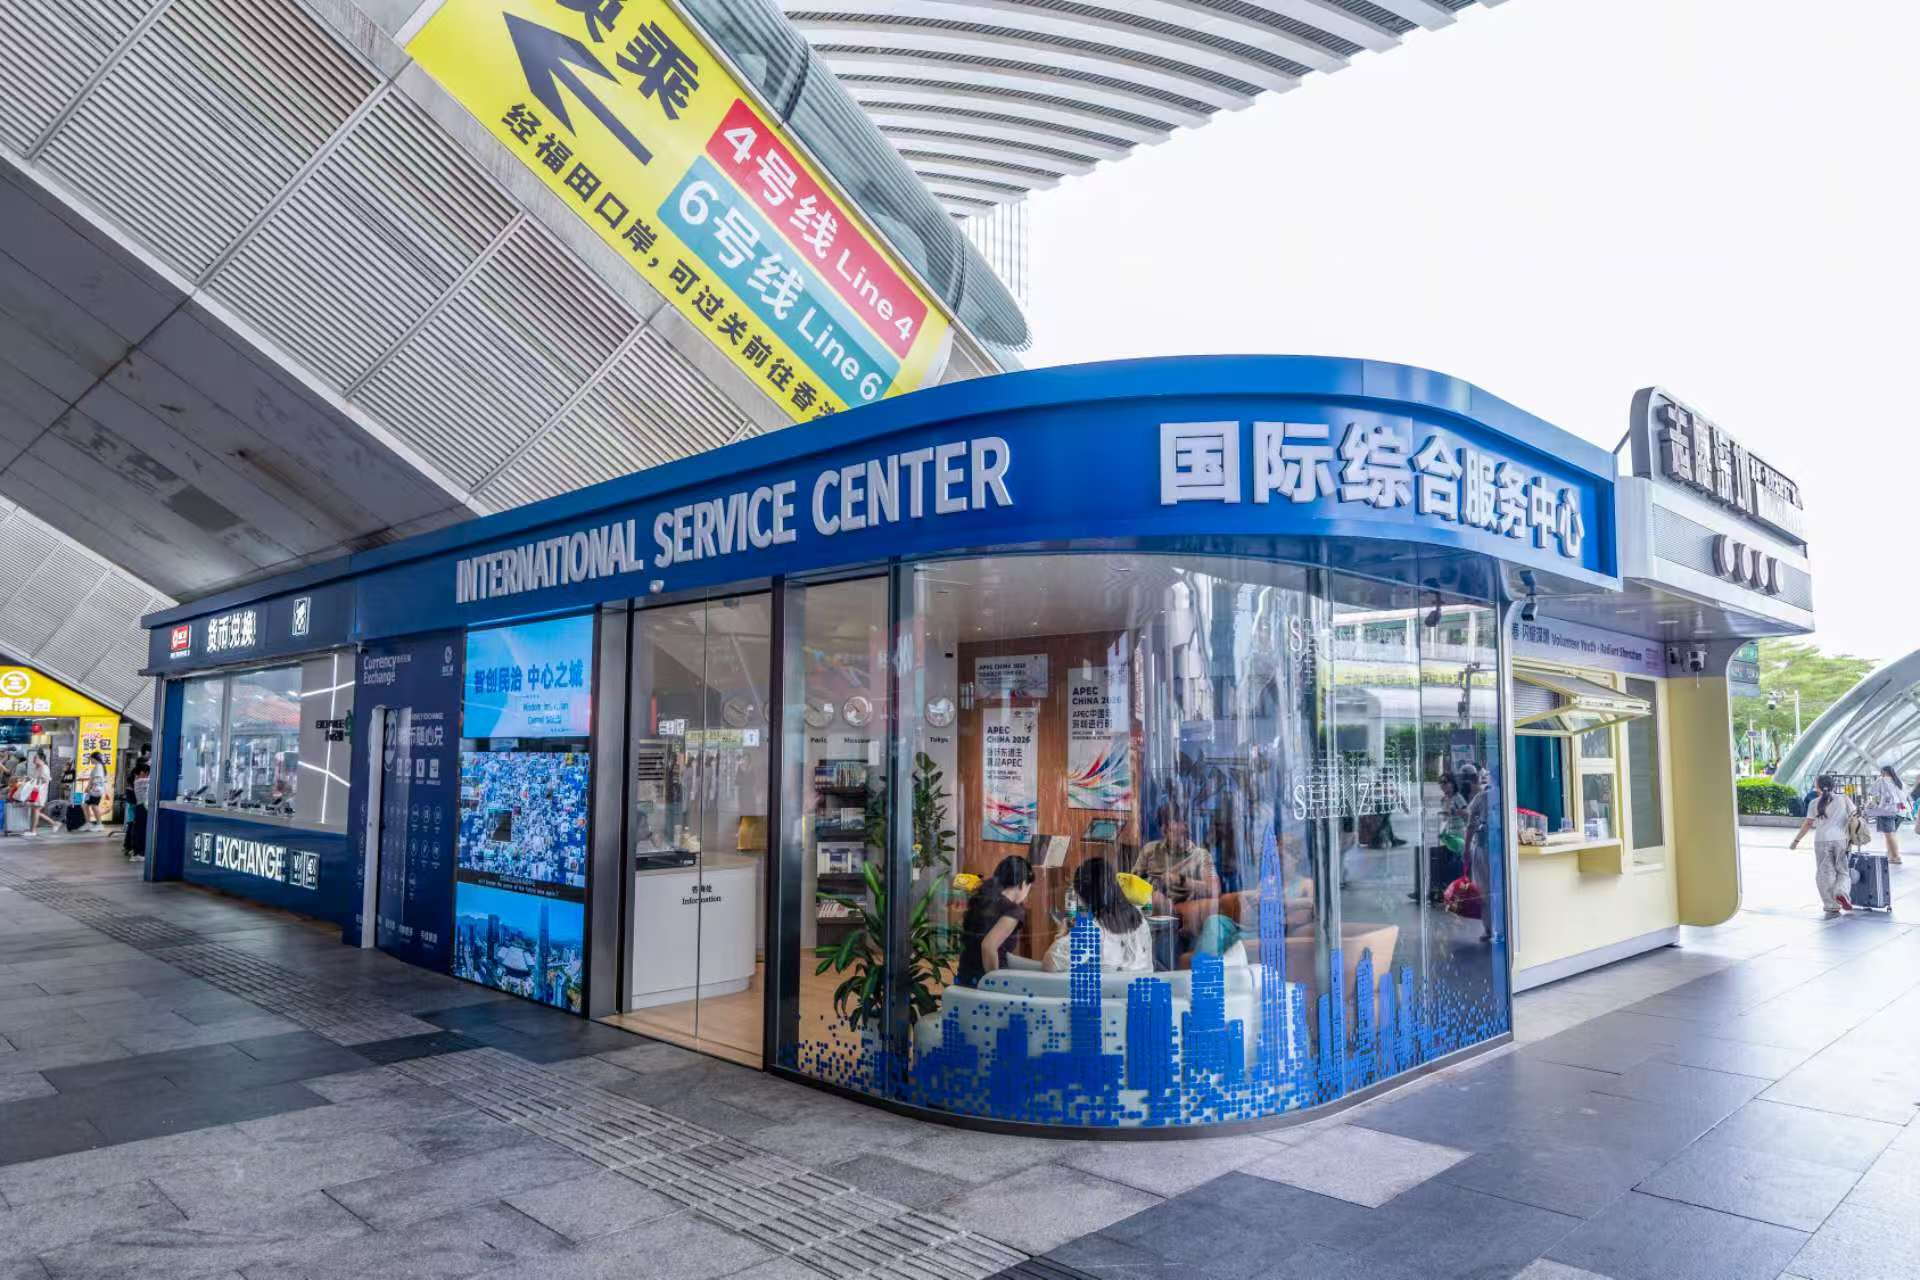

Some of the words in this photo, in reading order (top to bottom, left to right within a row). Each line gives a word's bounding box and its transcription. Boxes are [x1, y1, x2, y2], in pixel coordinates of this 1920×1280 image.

[723, 126, 837, 259] 4号线
[836, 249, 894, 321] Line
[895, 316, 914, 341] 4
[679, 180, 806, 320] 6号线
[797, 306, 861, 380] Line
[860, 373, 883, 400] 6
[1159, 421, 1585, 558] 国际综合服务中心
[456, 519, 644, 604] INTERNATIONAL
[653, 480, 798, 568] SERVICE
[811, 436, 1014, 536] CENTER
[207, 610, 256, 652] 货币兑换
[363, 655, 396, 670] Currency
[363, 671, 396, 686] Exchange
[475, 665, 523, 693] 智创民治
[527, 659, 584, 691] 中心之城
[1072, 686, 1099, 696] APEC
[1072, 696, 1099, 705] CHINA
[986, 735, 1011, 744] CHINA
[987, 726, 1011, 735] APEC
[215, 835, 287, 882] EXCHANGE
